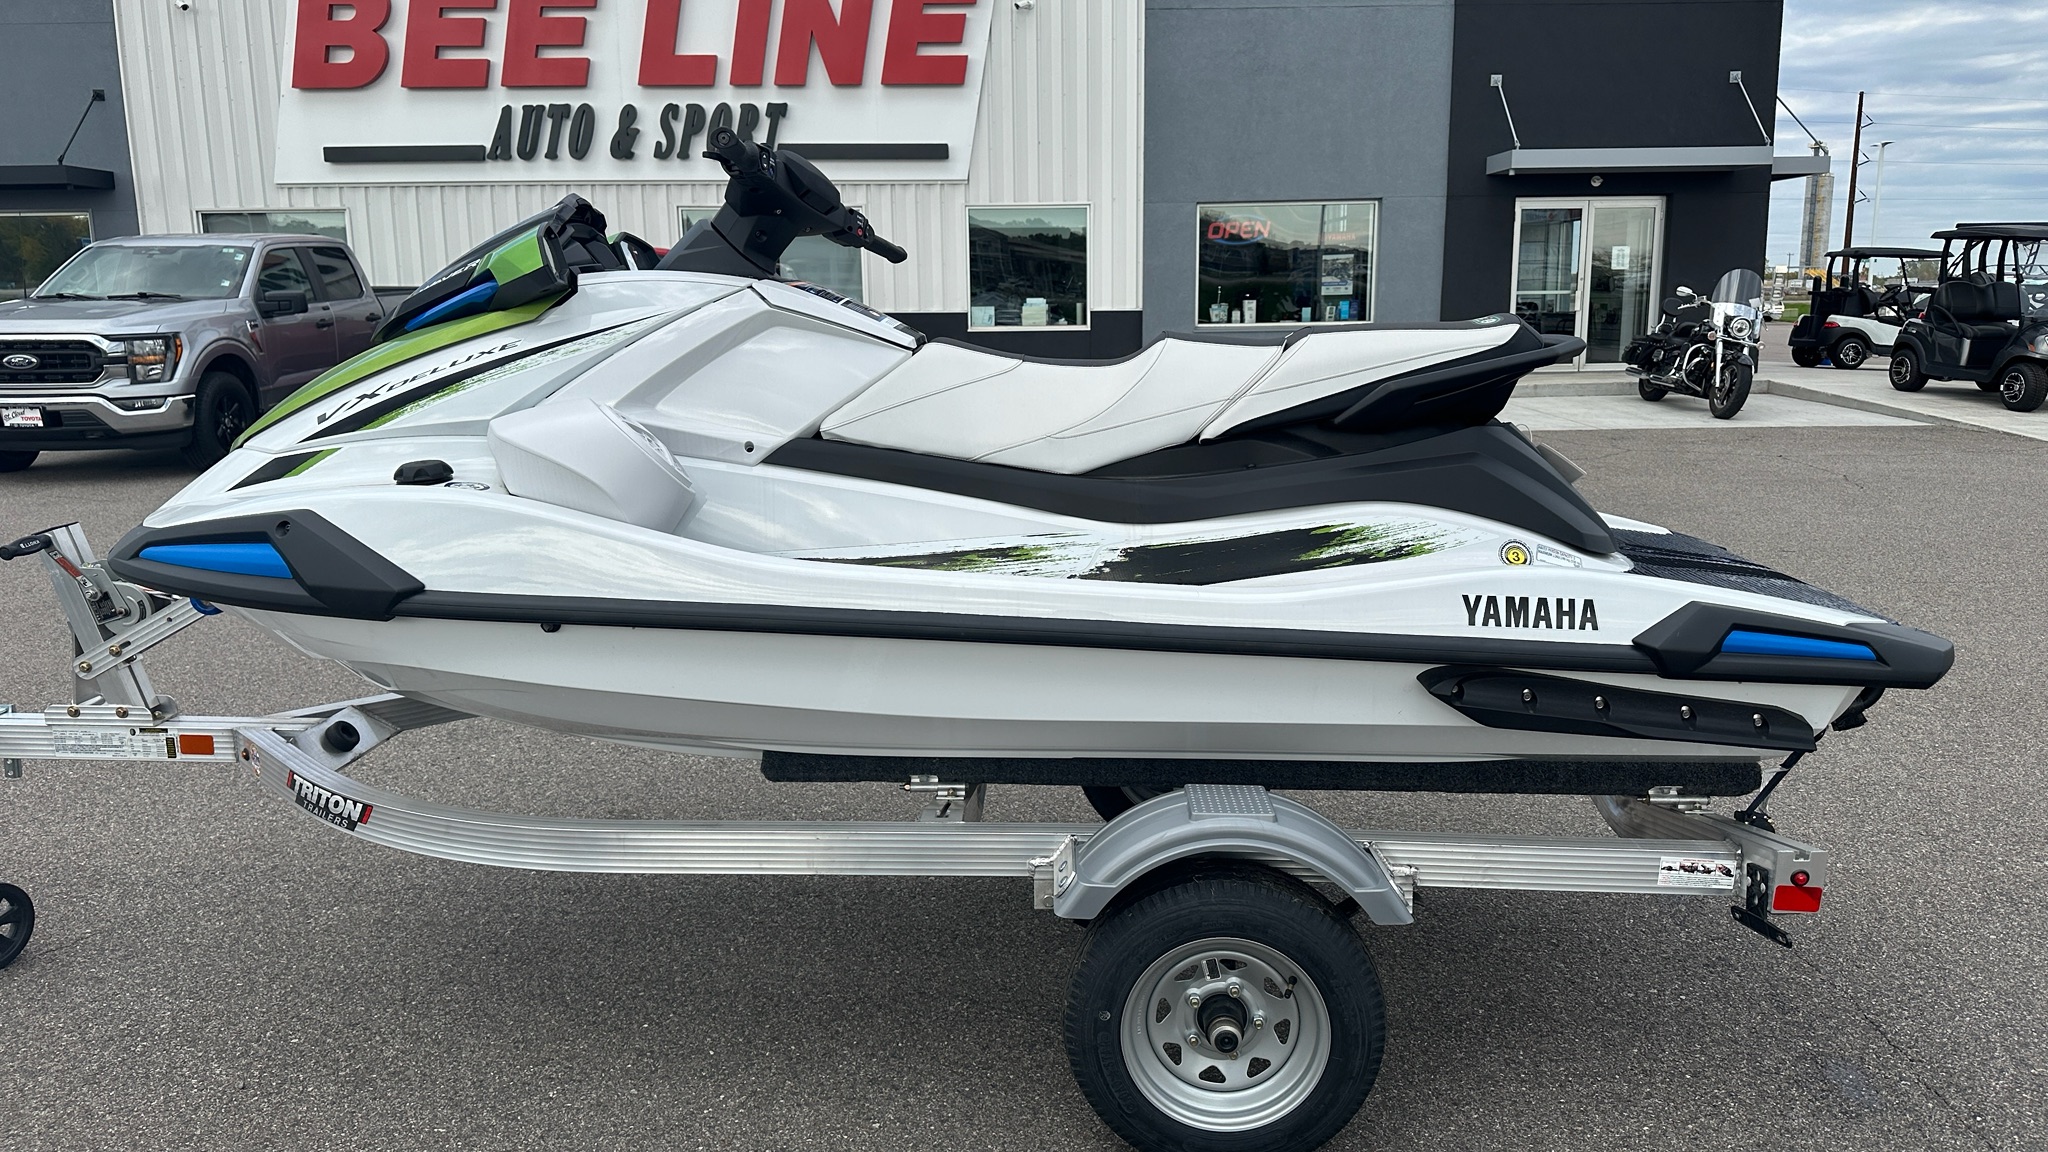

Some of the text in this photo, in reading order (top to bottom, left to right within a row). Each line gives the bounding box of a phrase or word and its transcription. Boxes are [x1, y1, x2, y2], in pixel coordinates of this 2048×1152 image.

[292, 0, 976, 90] BEE LINE
[486, 102, 789, 161] AUTO & SPORT
[1207, 219, 1271, 240] OPEN
[316, 337, 523, 426] VX DELUXE
[1511, 551, 1521, 562] 3
[1461, 593, 1599, 631] YAMAHA
[293, 773, 364, 822] TRITON
[302, 799, 349, 828] TRAILERS
